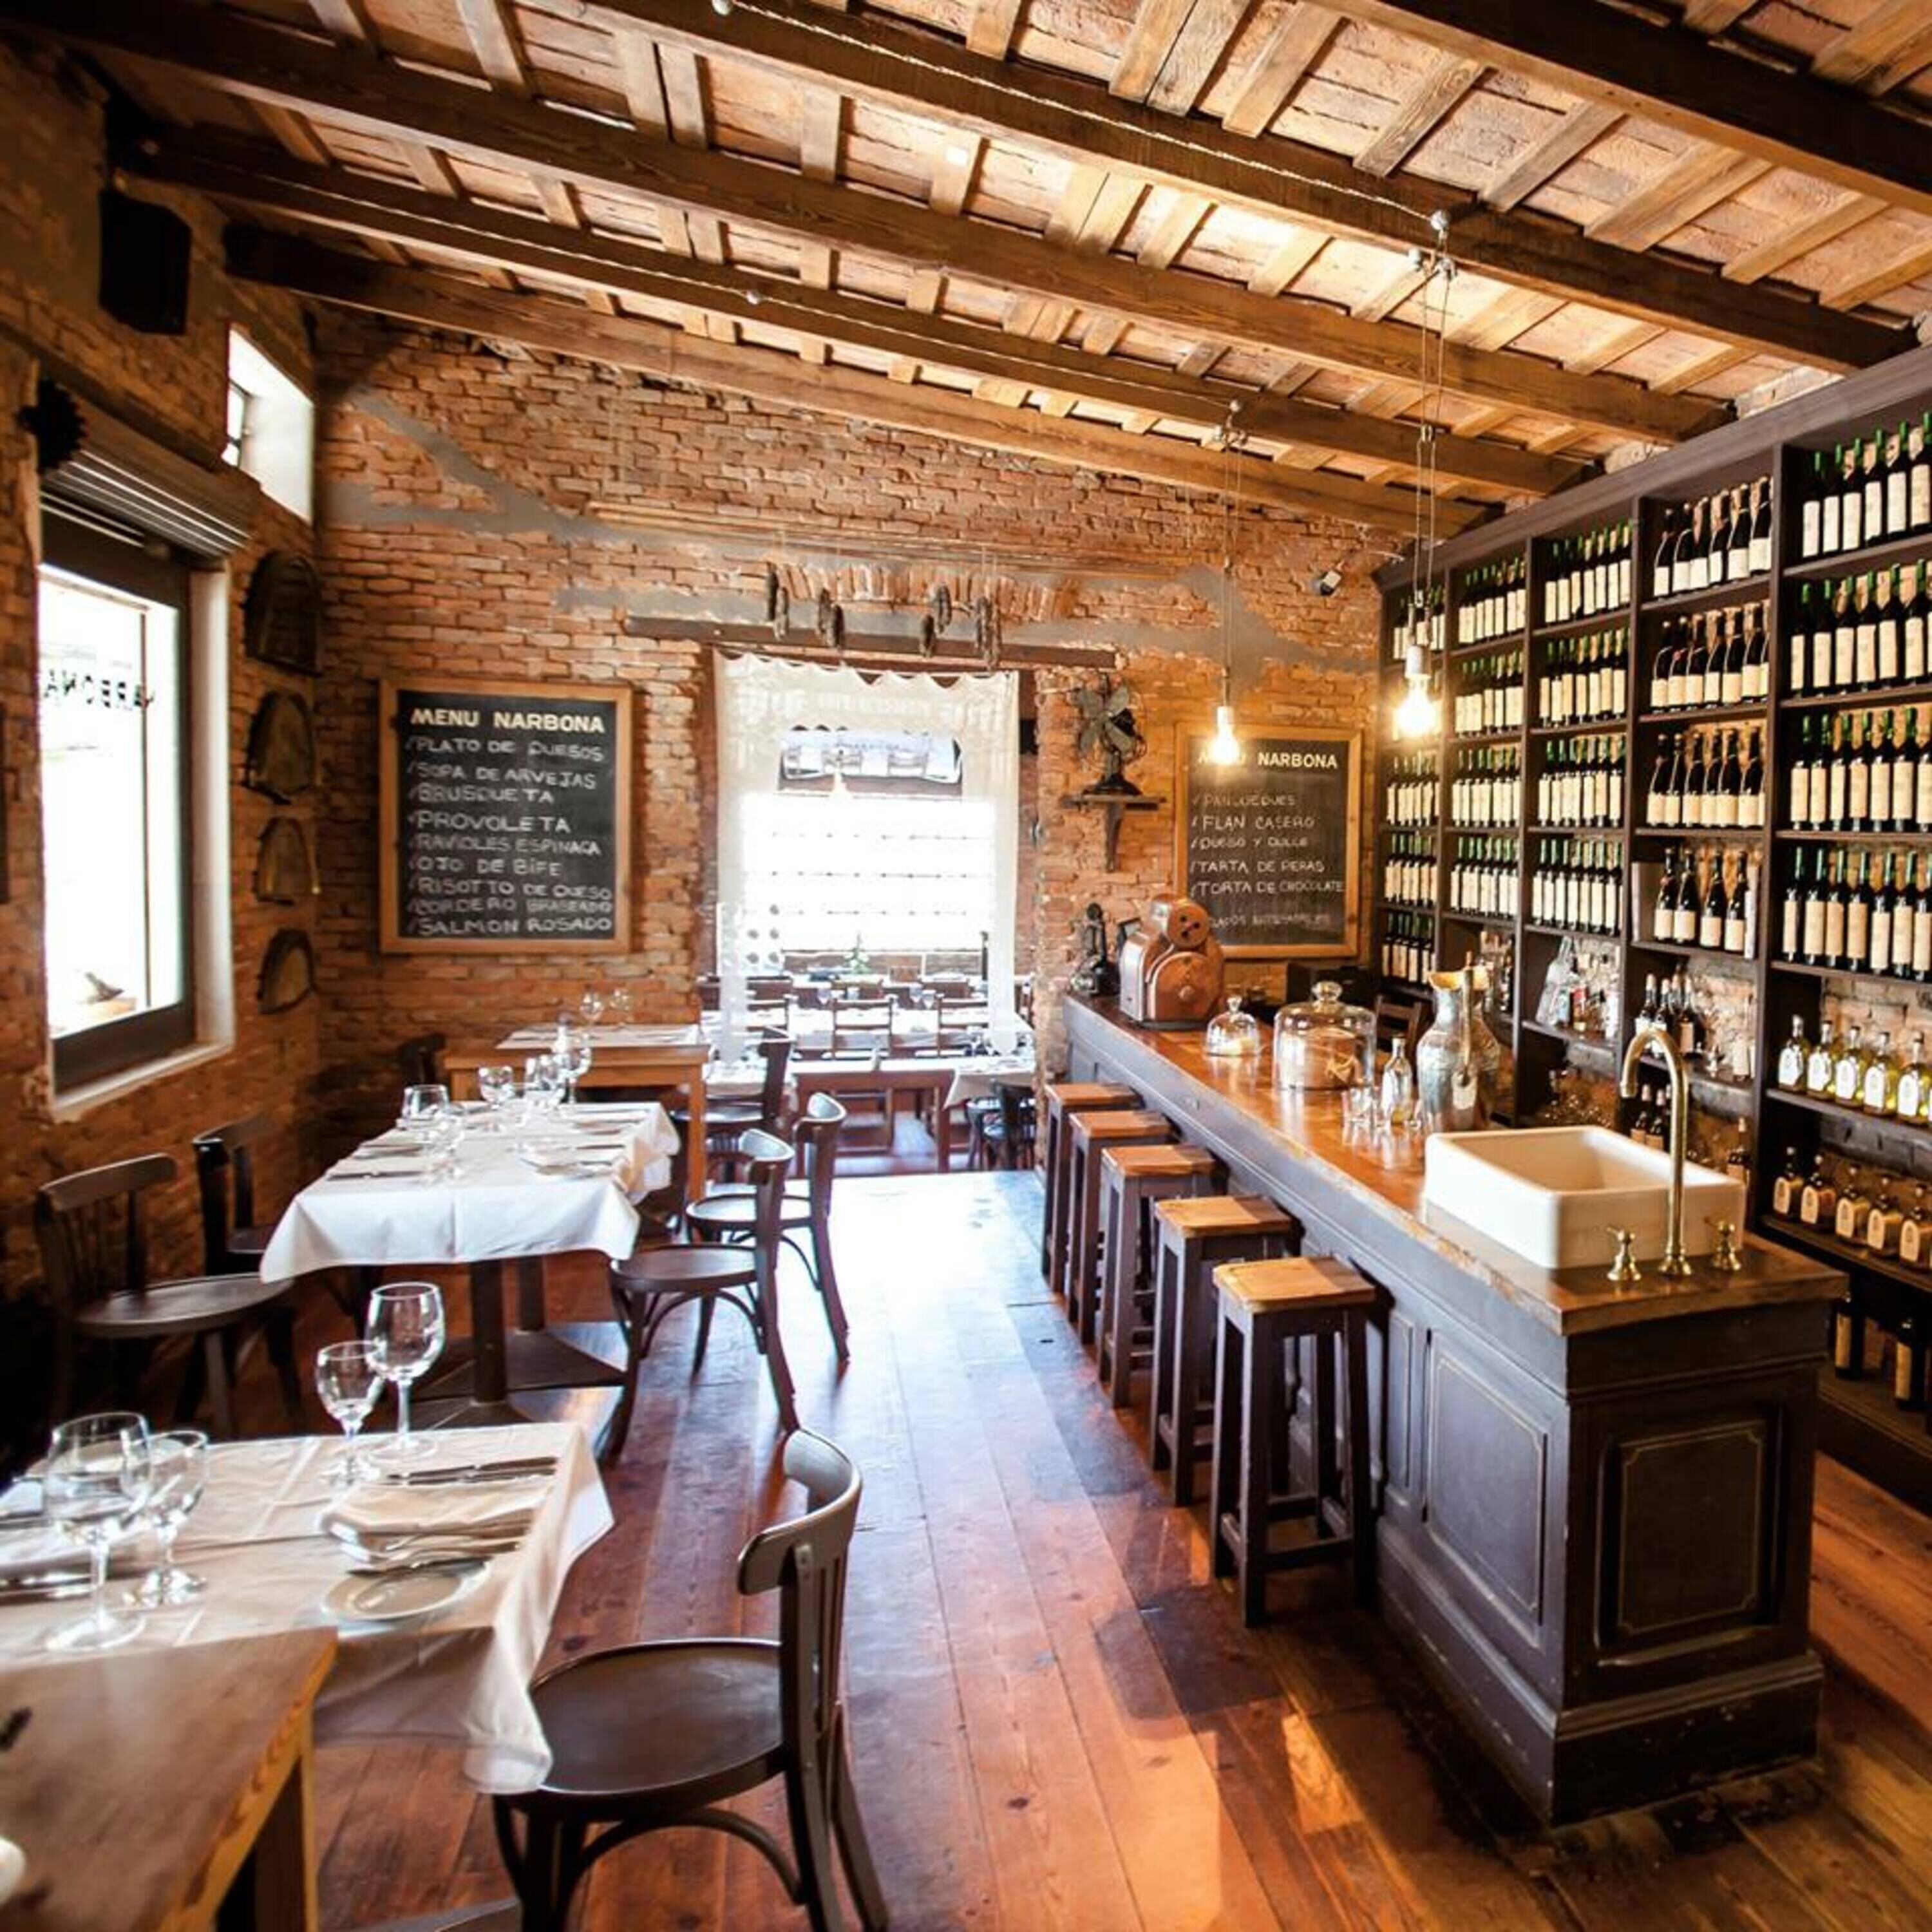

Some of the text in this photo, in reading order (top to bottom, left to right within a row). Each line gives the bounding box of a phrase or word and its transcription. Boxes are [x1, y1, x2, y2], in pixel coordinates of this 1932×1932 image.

[411, 708, 605, 733] MENU NARBONA
[417, 737, 481, 753] PLATO
[488, 741, 515, 753] DE
[1258, 752, 1338, 768] NARBONA
[417, 763, 597, 790] SOPA DE ARVEJAS
[417, 810, 571, 833] PROVOLETA
[1203, 815, 1315, 831] FLAN CASERO
[417, 856, 464, 872] OJO
[477, 858, 505, 873] DE
[1198, 860, 1325, 874] TARTA DE PERAS
[417, 876, 515, 896] RISOTTO
[523, 884, 549, 897] DE
[1197, 880, 1345, 897] TORTA DE CHOCOLATE
[419, 916, 612, 936] SALMON ROSADO
